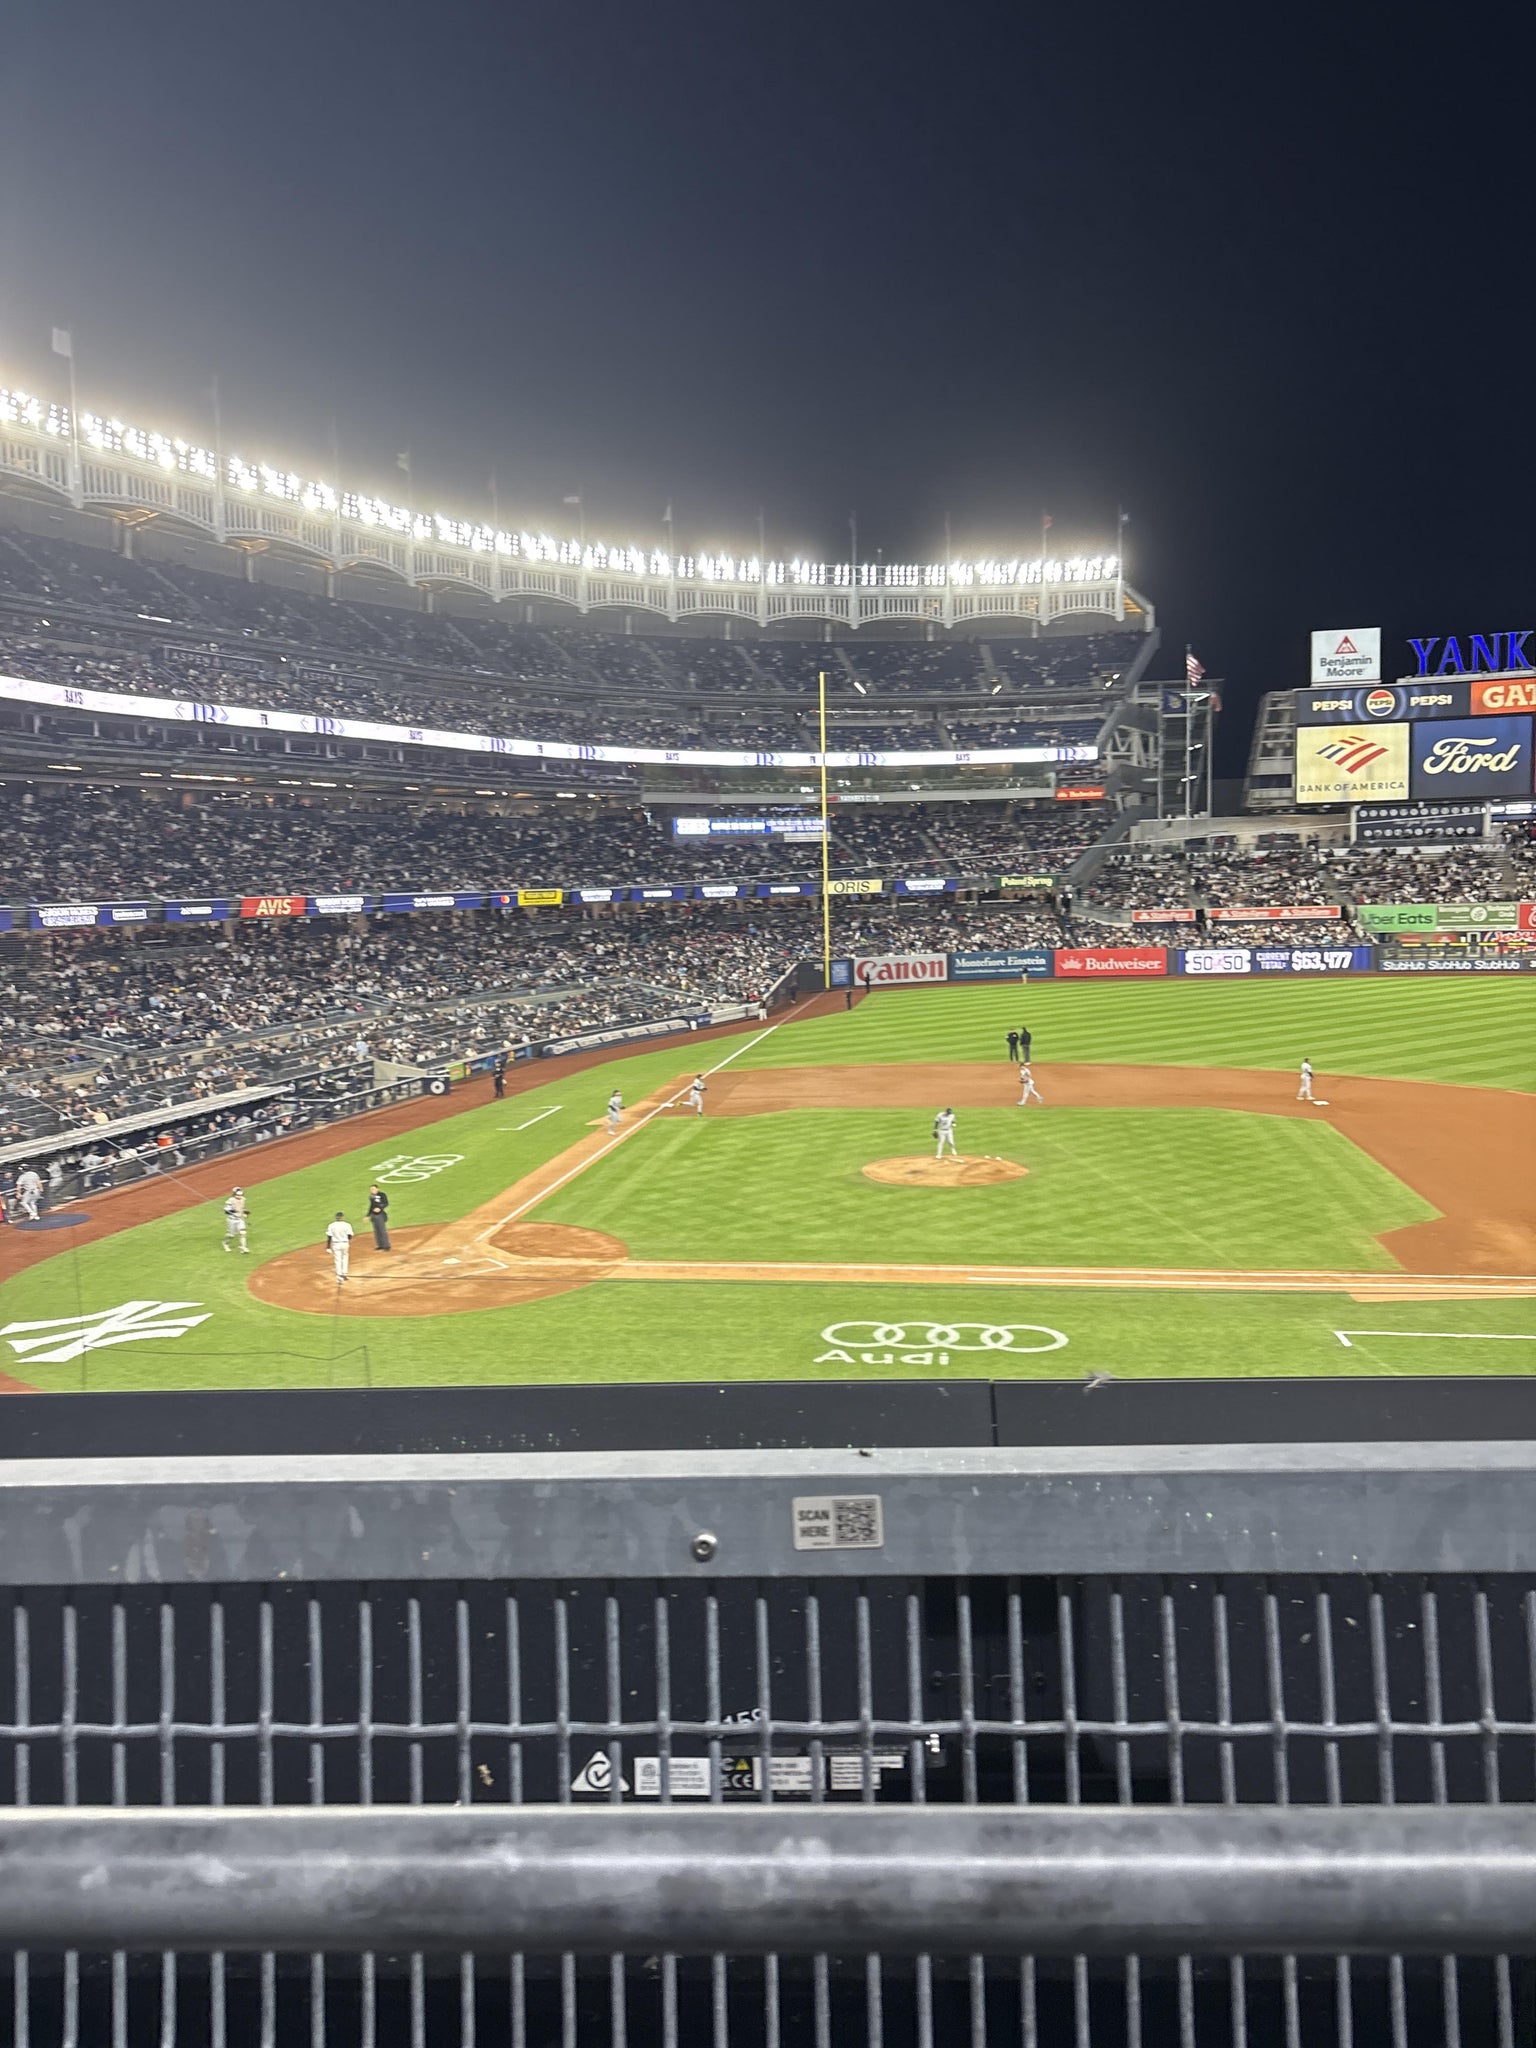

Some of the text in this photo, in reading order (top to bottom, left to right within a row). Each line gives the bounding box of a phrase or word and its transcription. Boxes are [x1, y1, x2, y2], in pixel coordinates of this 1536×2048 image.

[1407, 630, 1535, 677] YANK
[1320, 655, 1372, 668] Benjamin
[1327, 668, 1363, 677] Moore
[1312, 699, 1353, 711] PEPSI
[1369, 699, 1393, 707] PEPSI
[1410, 694, 1453, 706] PEPSI
[1423, 737, 1521, 775] Ford
[1299, 781, 1405, 793] BANK OF AMERICA
[833, 881, 871, 893] ORIS
[256, 898, 292, 916] AVIS
[1398, 913, 1433, 925] Eats
[955, 956, 1047, 967] Montefiore Einstein
[1085, 957, 1162, 971] Budweiser
[1292, 950, 1353, 971] $63,477
[1383, 961, 1426, 971] StubHub
[1428, 961, 1472, 970] StubHub
[1474, 960, 1520, 970] StubHub
[856, 959, 944, 983] Canon
[813, 1349, 950, 1365] Audi
[798, 1510, 829, 1521] SCAN
[800, 1526, 829, 1537] HERE
